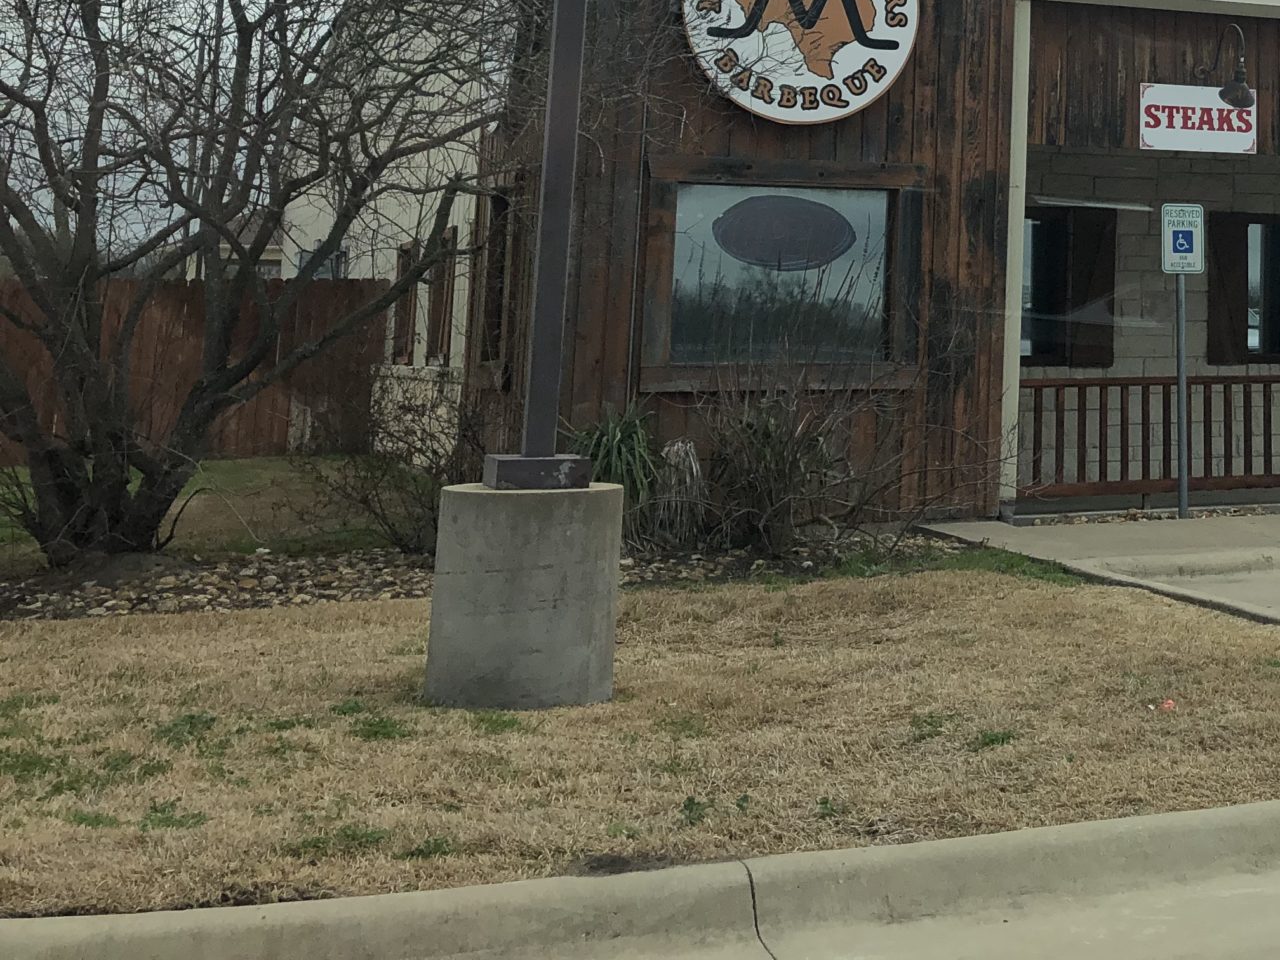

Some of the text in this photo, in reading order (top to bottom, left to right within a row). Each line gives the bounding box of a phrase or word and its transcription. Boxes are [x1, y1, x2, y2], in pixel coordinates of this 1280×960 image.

[714, 48, 887, 110] BARBEQUE
[1144, 104, 1253, 133] STEAKS
[1165, 209, 1200, 218] RESERVED
[1167, 219, 1198, 228] PARKING
